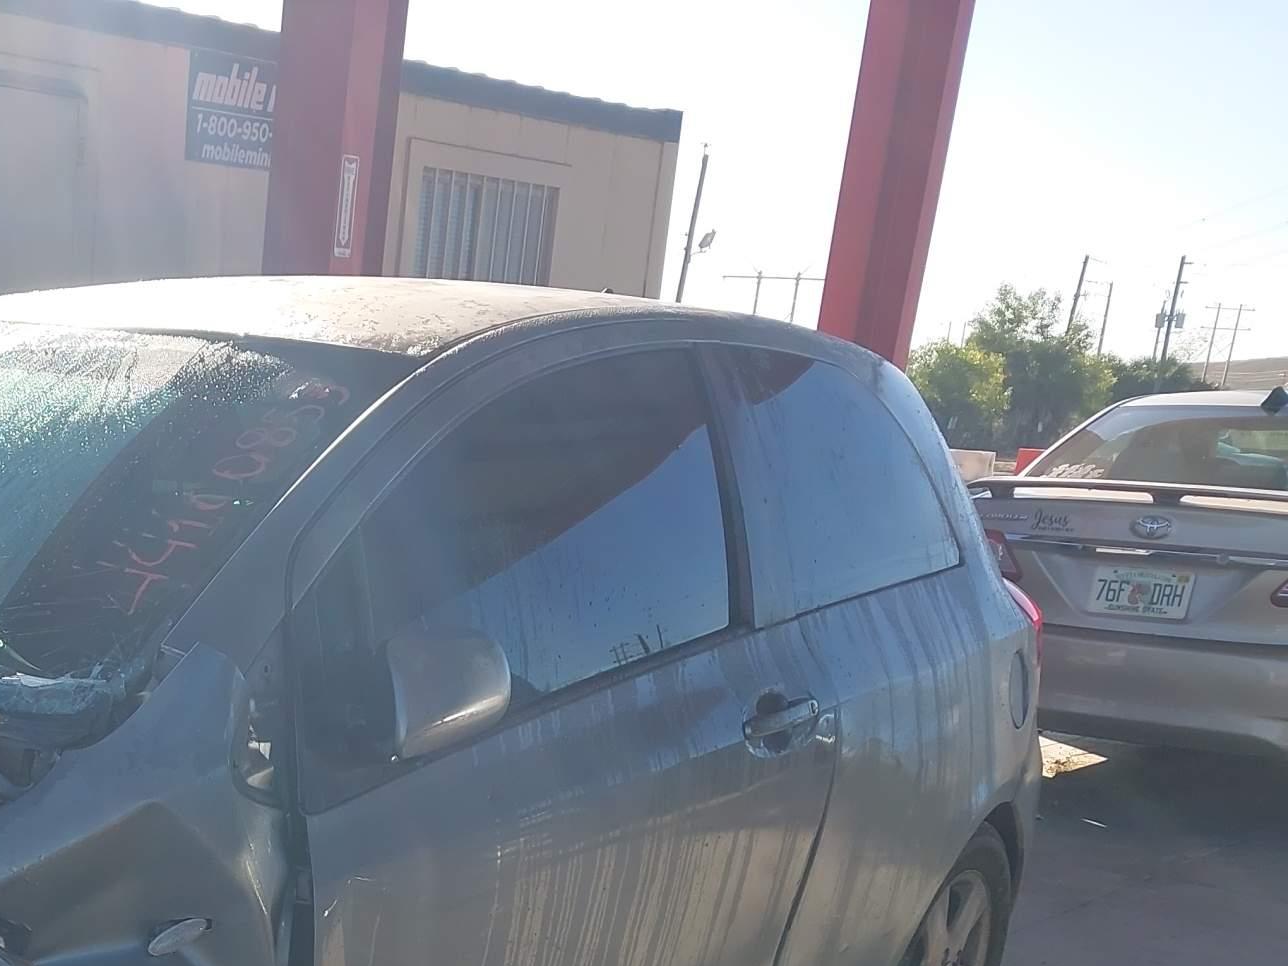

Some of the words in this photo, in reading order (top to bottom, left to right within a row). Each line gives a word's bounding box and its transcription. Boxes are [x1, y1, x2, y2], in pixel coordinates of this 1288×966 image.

[192, 62, 267, 111] mobile
[1031, 509, 1071, 530] Jesus
[1096, 578, 1131, 603] 76F
[1149, 582, 1186, 607] DRH
